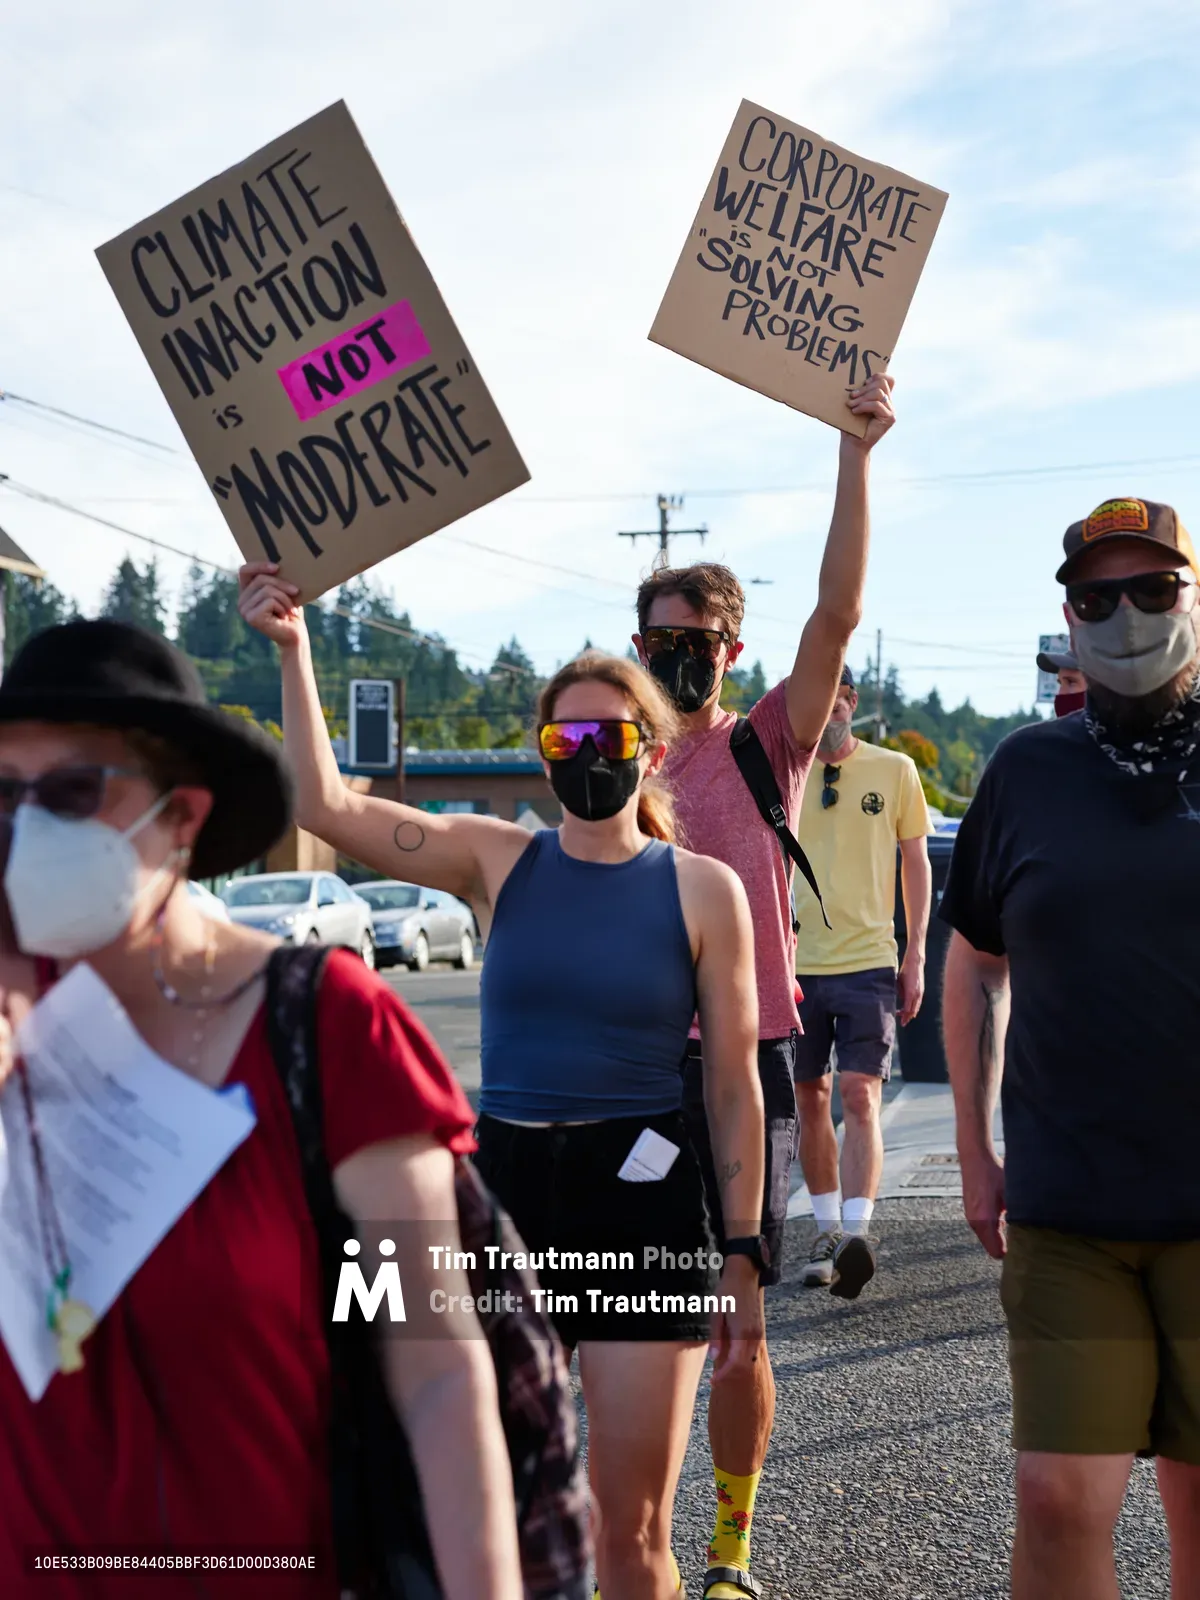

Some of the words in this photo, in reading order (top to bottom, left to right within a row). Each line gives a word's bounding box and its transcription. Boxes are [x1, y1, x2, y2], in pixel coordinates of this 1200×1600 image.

[130, 148, 348, 318] CLIMATE
[713, 166, 897, 288] WELFARE
[738, 116, 932, 243] CORPORATE
[161, 222, 387, 399] INACTION
[696, 228, 865, 333] "SOLVING
[729, 224, 752, 249] is
[767, 246, 837, 288] NOT
[214, 404, 244, 430] is
[302, 319, 397, 402] NOT
[212, 358, 492, 564] "MODERATE"
